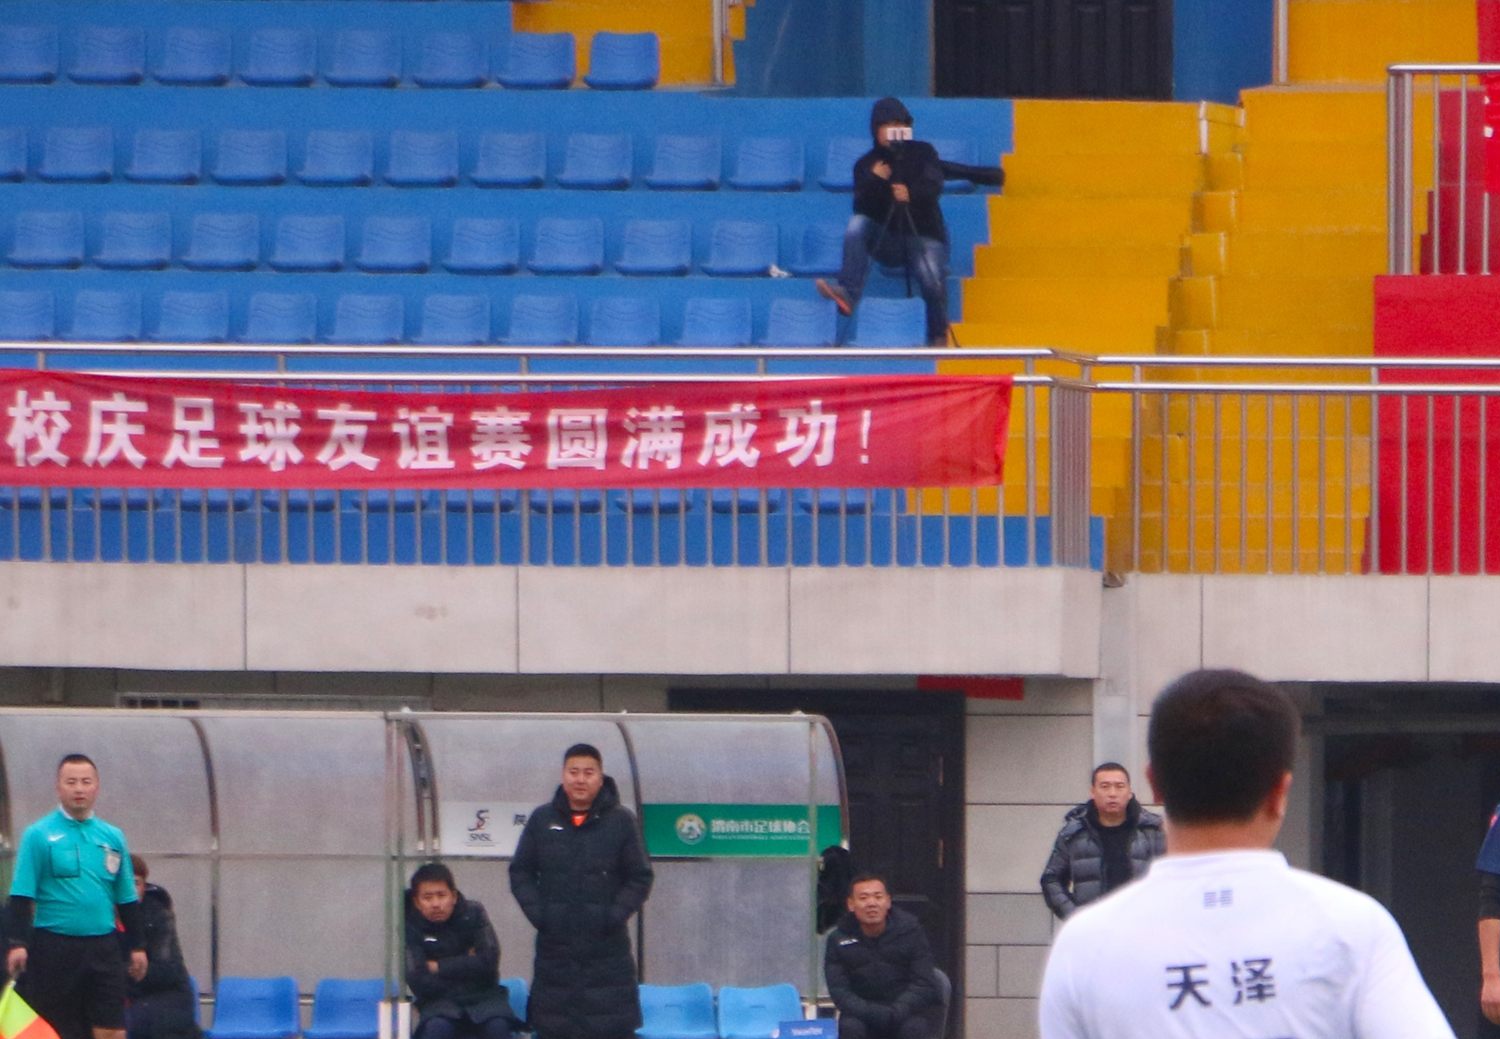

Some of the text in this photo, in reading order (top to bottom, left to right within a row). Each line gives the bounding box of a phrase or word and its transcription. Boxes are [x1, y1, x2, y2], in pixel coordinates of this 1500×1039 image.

[6, 388, 872, 471] 校庆足球友谊赛圆满成功！
[1166, 957, 1276, 1010] 天泽
